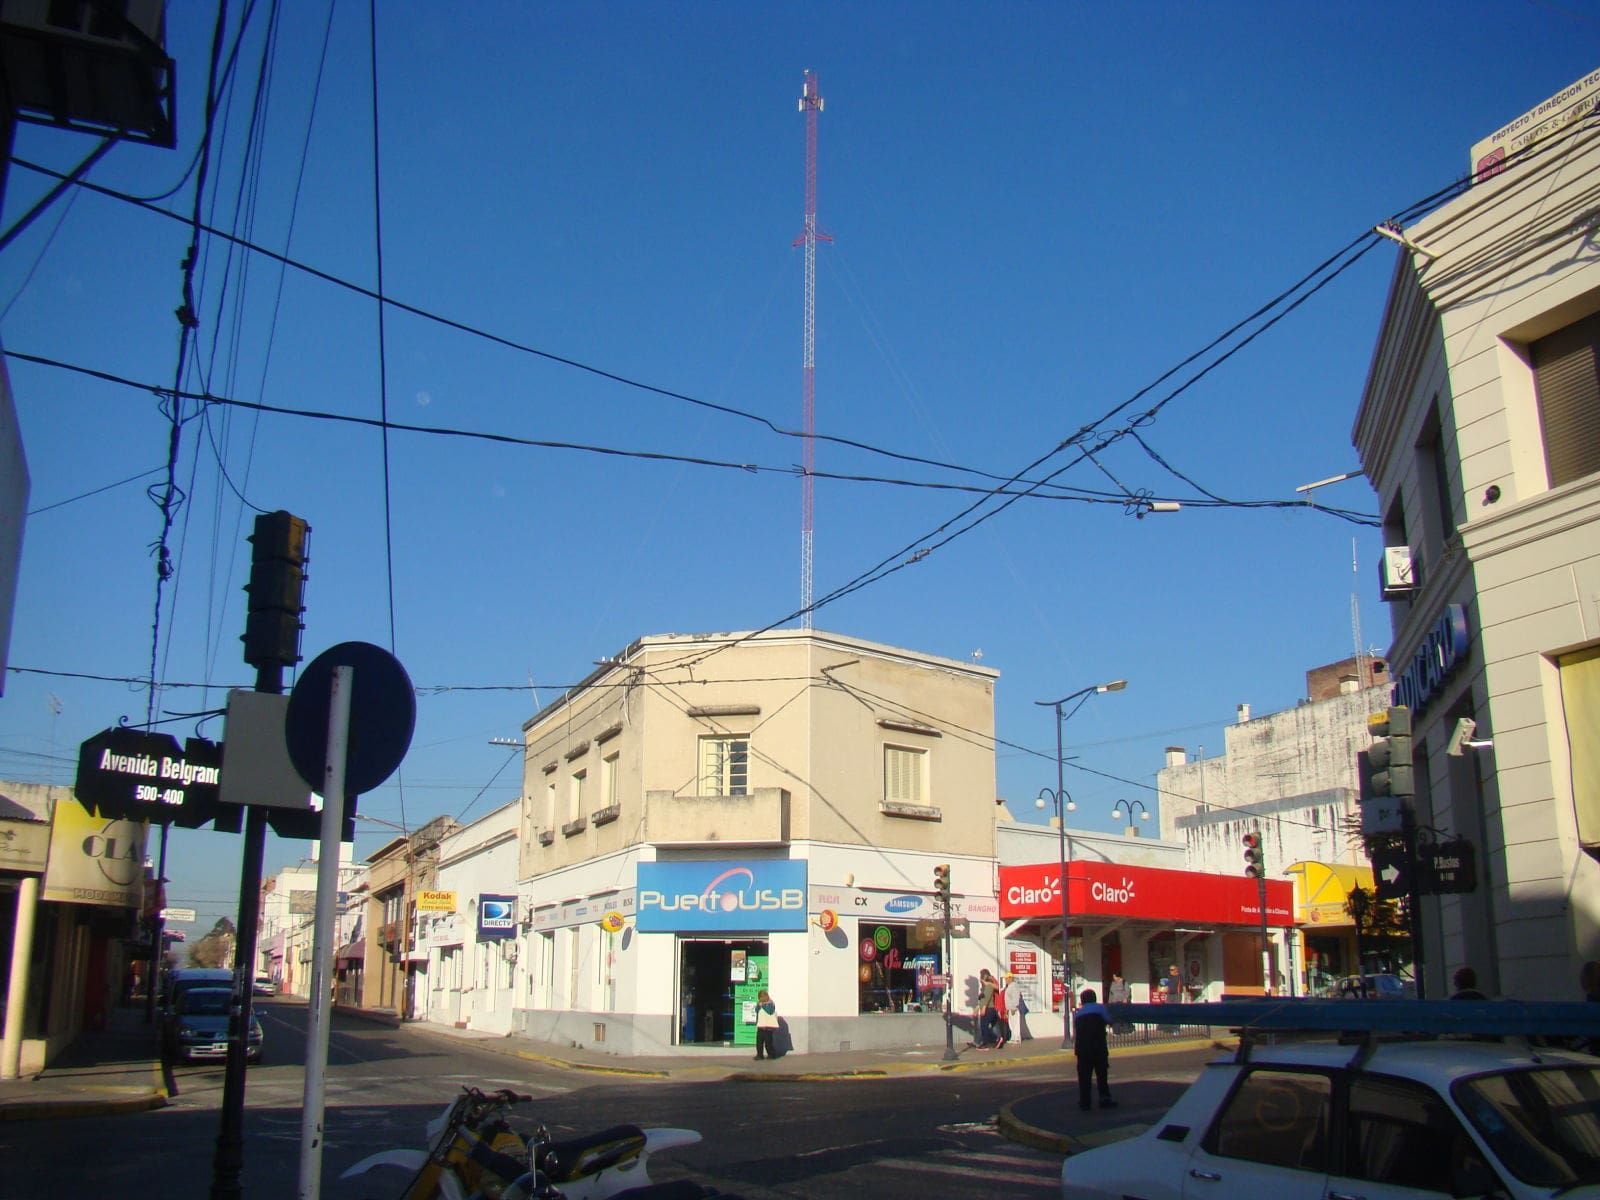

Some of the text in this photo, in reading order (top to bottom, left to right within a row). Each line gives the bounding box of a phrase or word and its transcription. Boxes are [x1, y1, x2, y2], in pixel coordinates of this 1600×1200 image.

[1492, 115, 1530, 143] PROYECTO
[1531, 111, 1537, 119] Y
[1538, 84, 1582, 115] DIRECCION
[100, 748, 158, 776] Avenida
[136, 785, 184, 805] 500-400
[423, 892, 452, 900] Kodak
[854, 897, 868, 906] CX
[1007, 886, 1052, 904] Claro
[1091, 882, 1128, 903] Claro
[889, 898, 919, 908] SAMSUNG
[484, 919, 511, 927] DIRECTV
